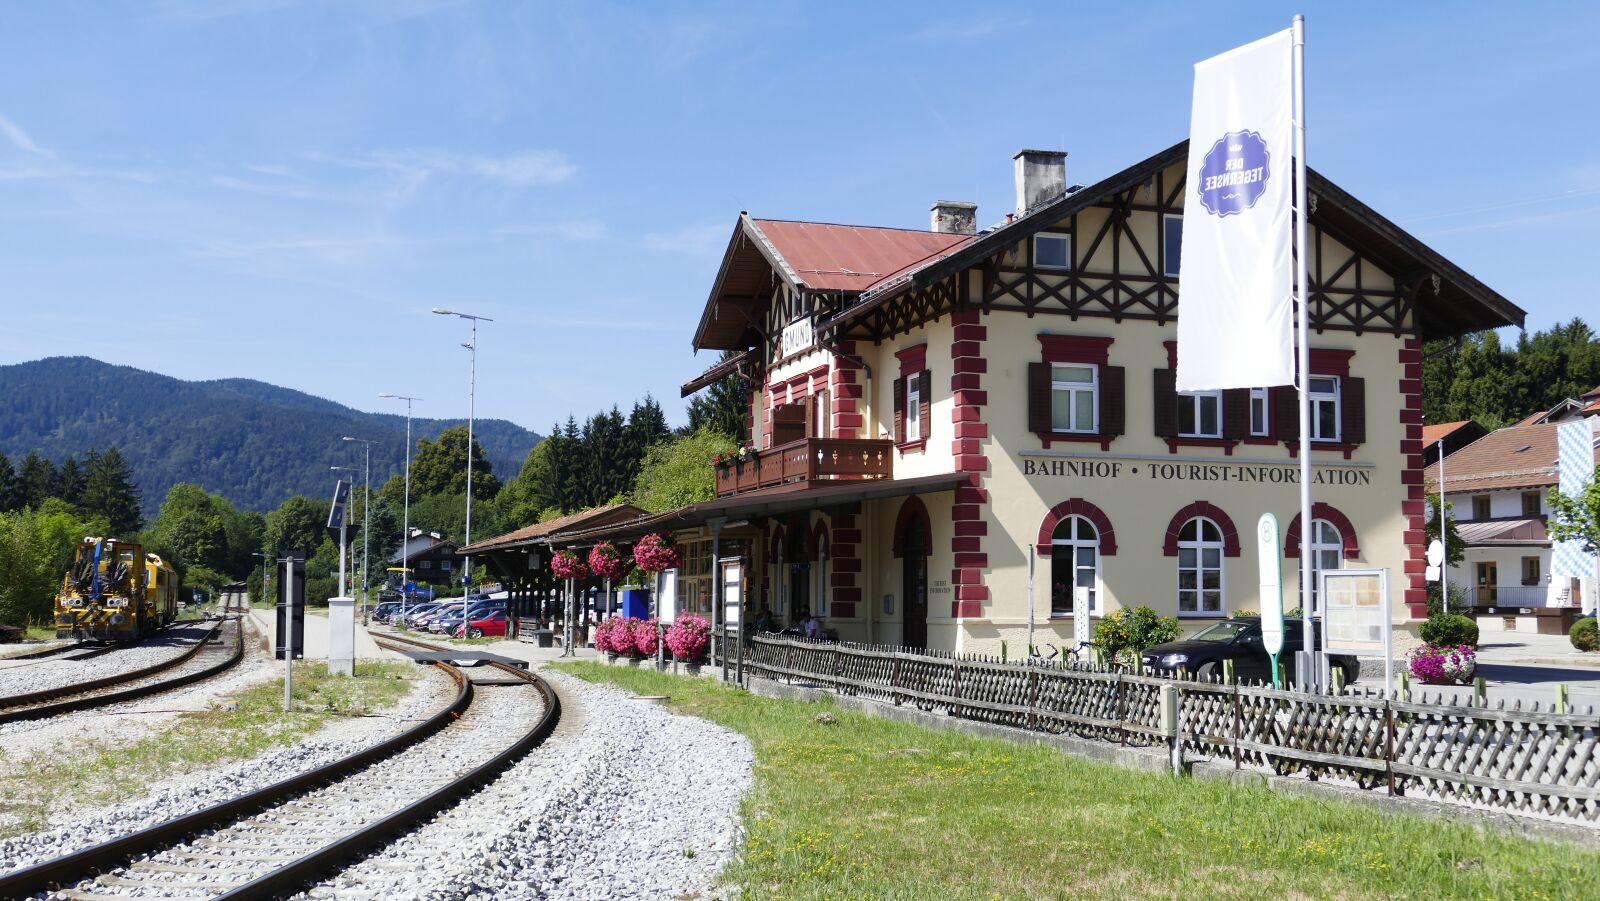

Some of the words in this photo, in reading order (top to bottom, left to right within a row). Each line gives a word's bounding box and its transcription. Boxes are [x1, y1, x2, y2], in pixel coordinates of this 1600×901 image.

[784, 322, 810, 353] GMUND
[1023, 460, 1122, 478] BAHNHOF
[1148, 464, 1371, 486] TOURIST-INFORATION
